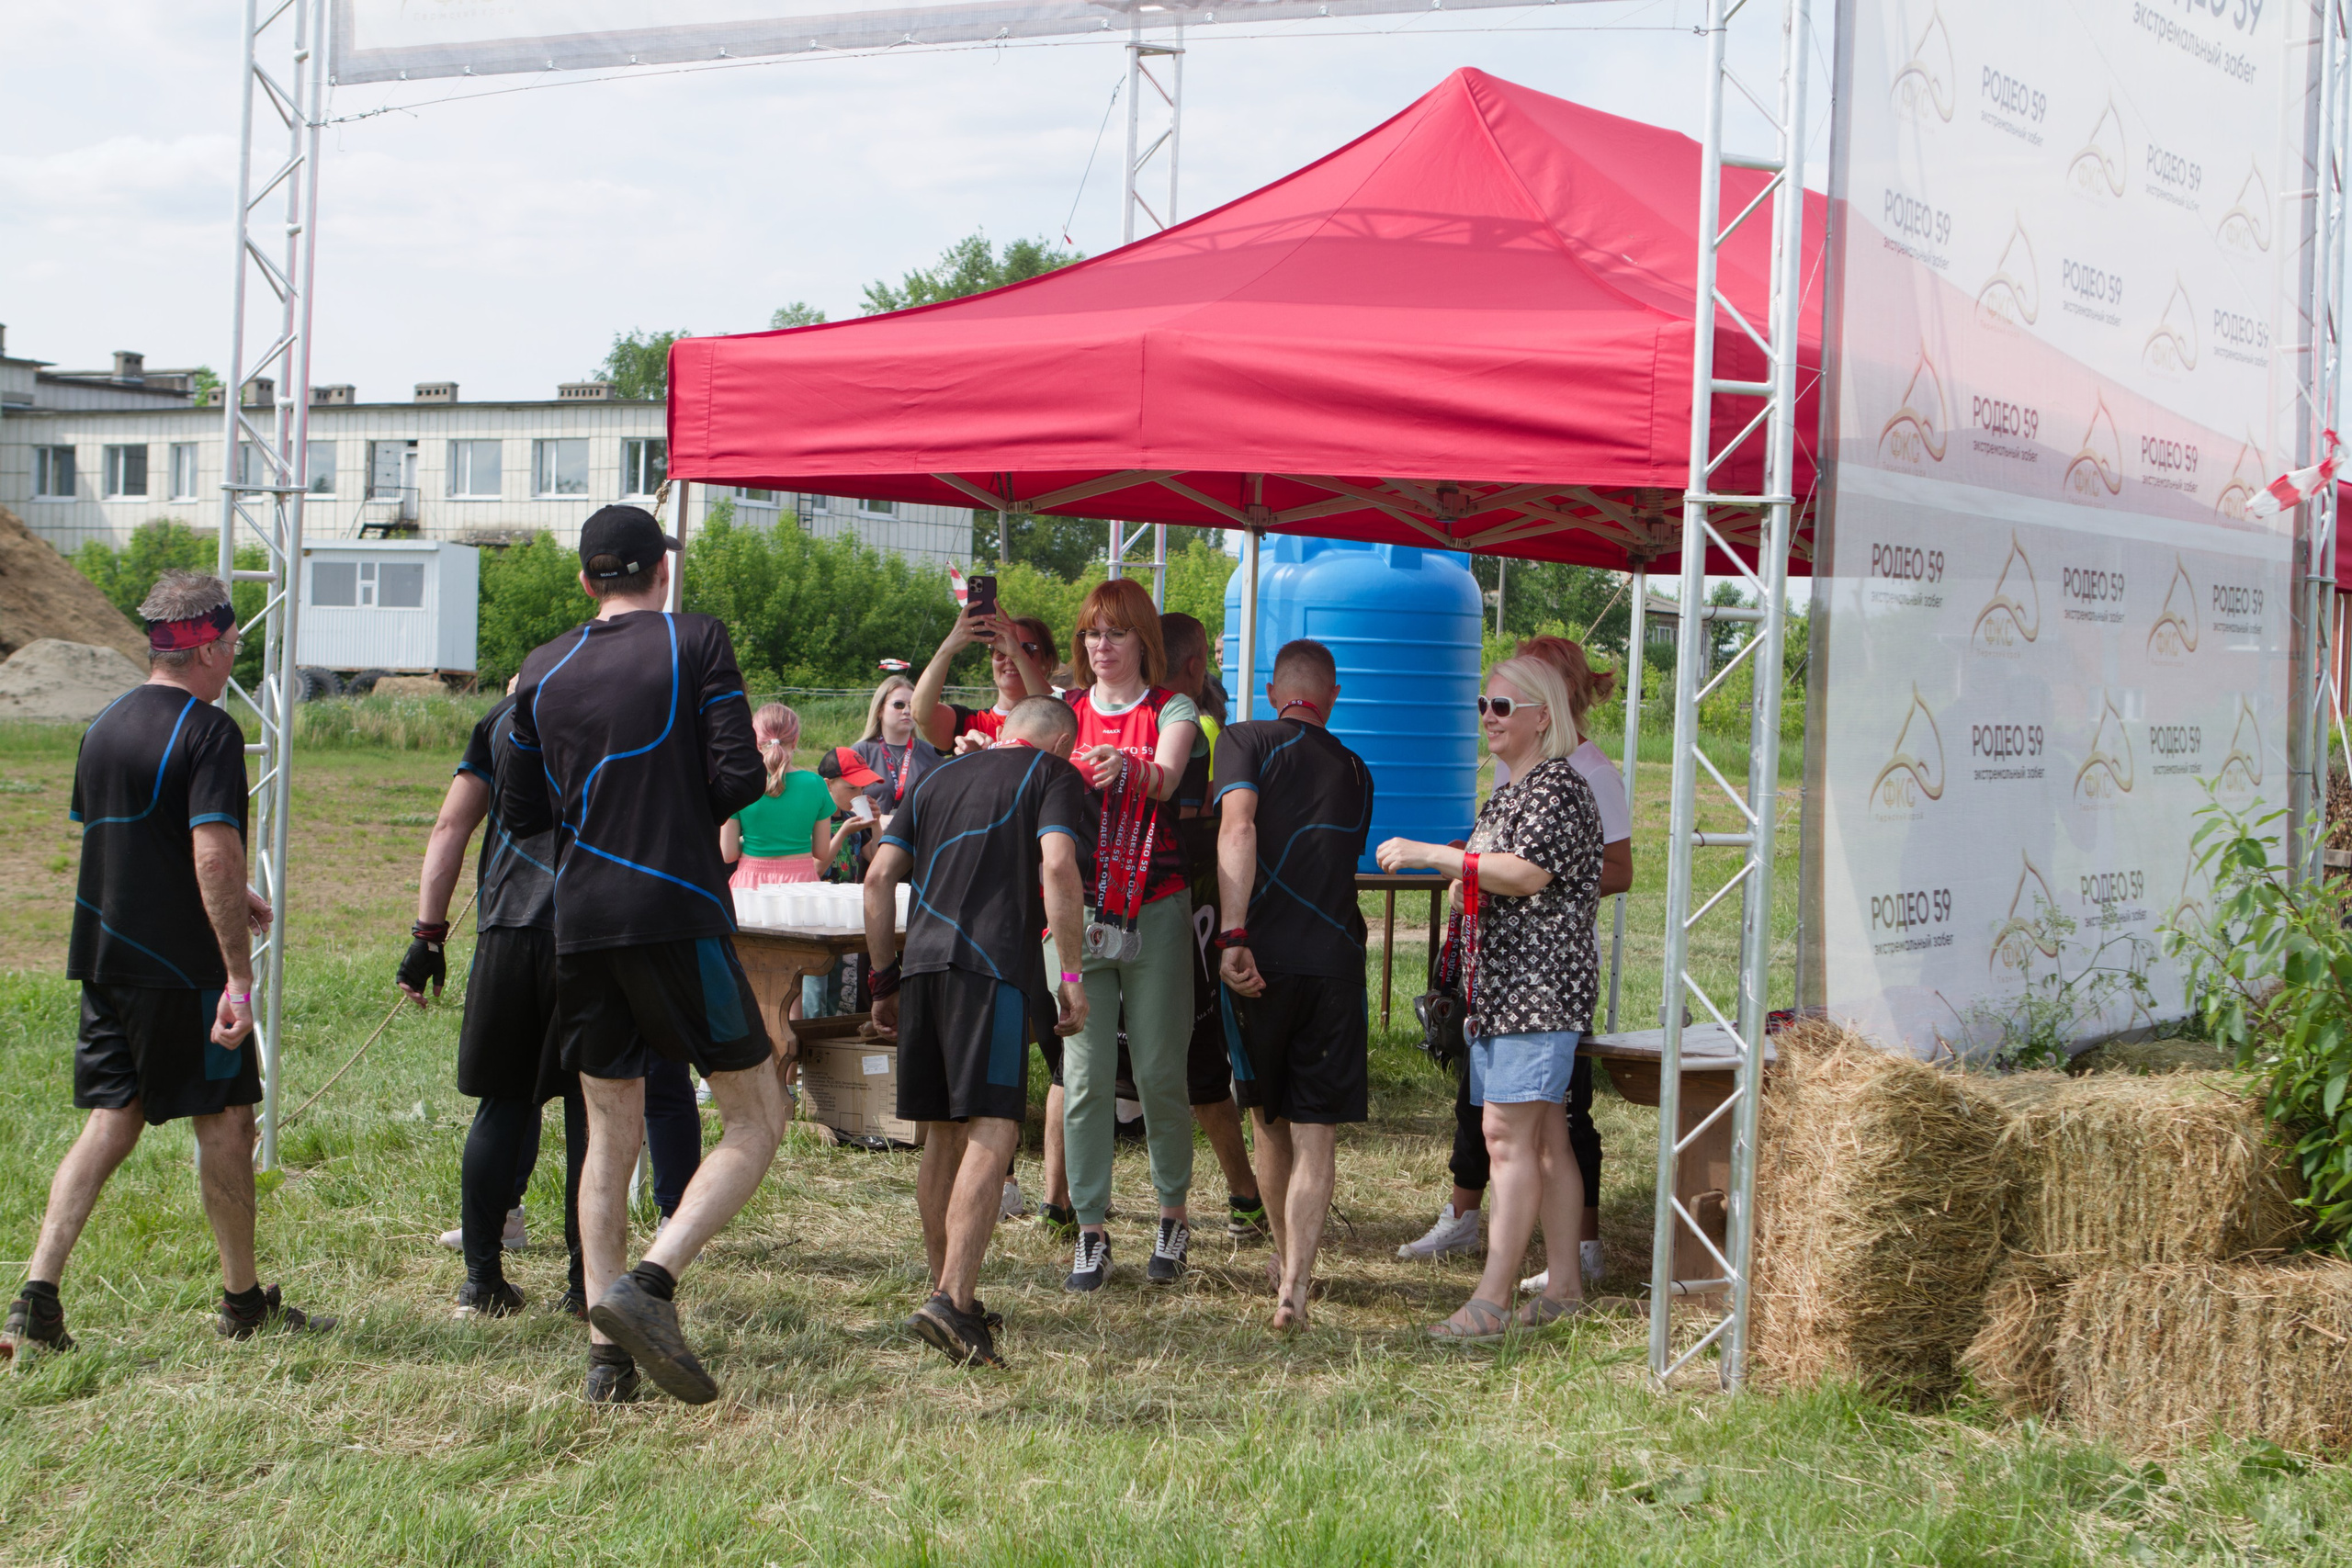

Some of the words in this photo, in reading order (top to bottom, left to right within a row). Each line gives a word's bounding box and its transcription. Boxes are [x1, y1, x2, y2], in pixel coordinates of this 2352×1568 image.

[2132, 1, 2222, 67] экстремальный
[2224, 53, 2257, 85] забег
[1981, 64, 2029, 116] РОДЕО
[2031, 90, 2047, 124] 59
[2146, 143, 2187, 186] РОДЕО
[2188, 163, 2201, 193] 59
[1884, 187, 1932, 240] РОДЕО
[1936, 209, 1951, 246] 59
[2063, 257, 2106, 303] РОДЕО
[2109, 274, 2123, 305] 59
[2213, 308, 2254, 346] РОДЕО
[2256, 321, 2269, 349] 59
[1973, 394, 2020, 438] РОДЕО
[2023, 407, 2039, 440] 59
[2142, 434, 2183, 473] РОДЕО
[2185, 444, 2199, 474] 59
[1871, 542, 1924, 586] РОДЕО
[1928, 549, 1945, 584] 59
[2063, 566, 2108, 604] РОДЕО
[2110, 572, 2125, 603] 59
[2212, 584, 2249, 616] РОДЕО
[2252, 588, 2265, 615] 59
[1141, 746, 1154, 755] 59
[1972, 724, 2025, 762] РОДЕО
[2028, 724, 2044, 757] 59
[2150, 725, 2188, 759] РОДЕО
[2189, 725, 2202, 753] 59
[1100, 812, 1108, 847] РОДЕО
[1143, 822, 1155, 857] РОДЕО
[1139, 860, 1148, 872] 59
[2080, 871, 2128, 906] РОДЕО
[2130, 869, 2144, 900] 59
[1871, 889, 1929, 933] РОДЕО
[1933, 887, 1952, 923] 59
[1873, 934, 1932, 956] экстремальный
[1932, 932, 1954, 948] забег
